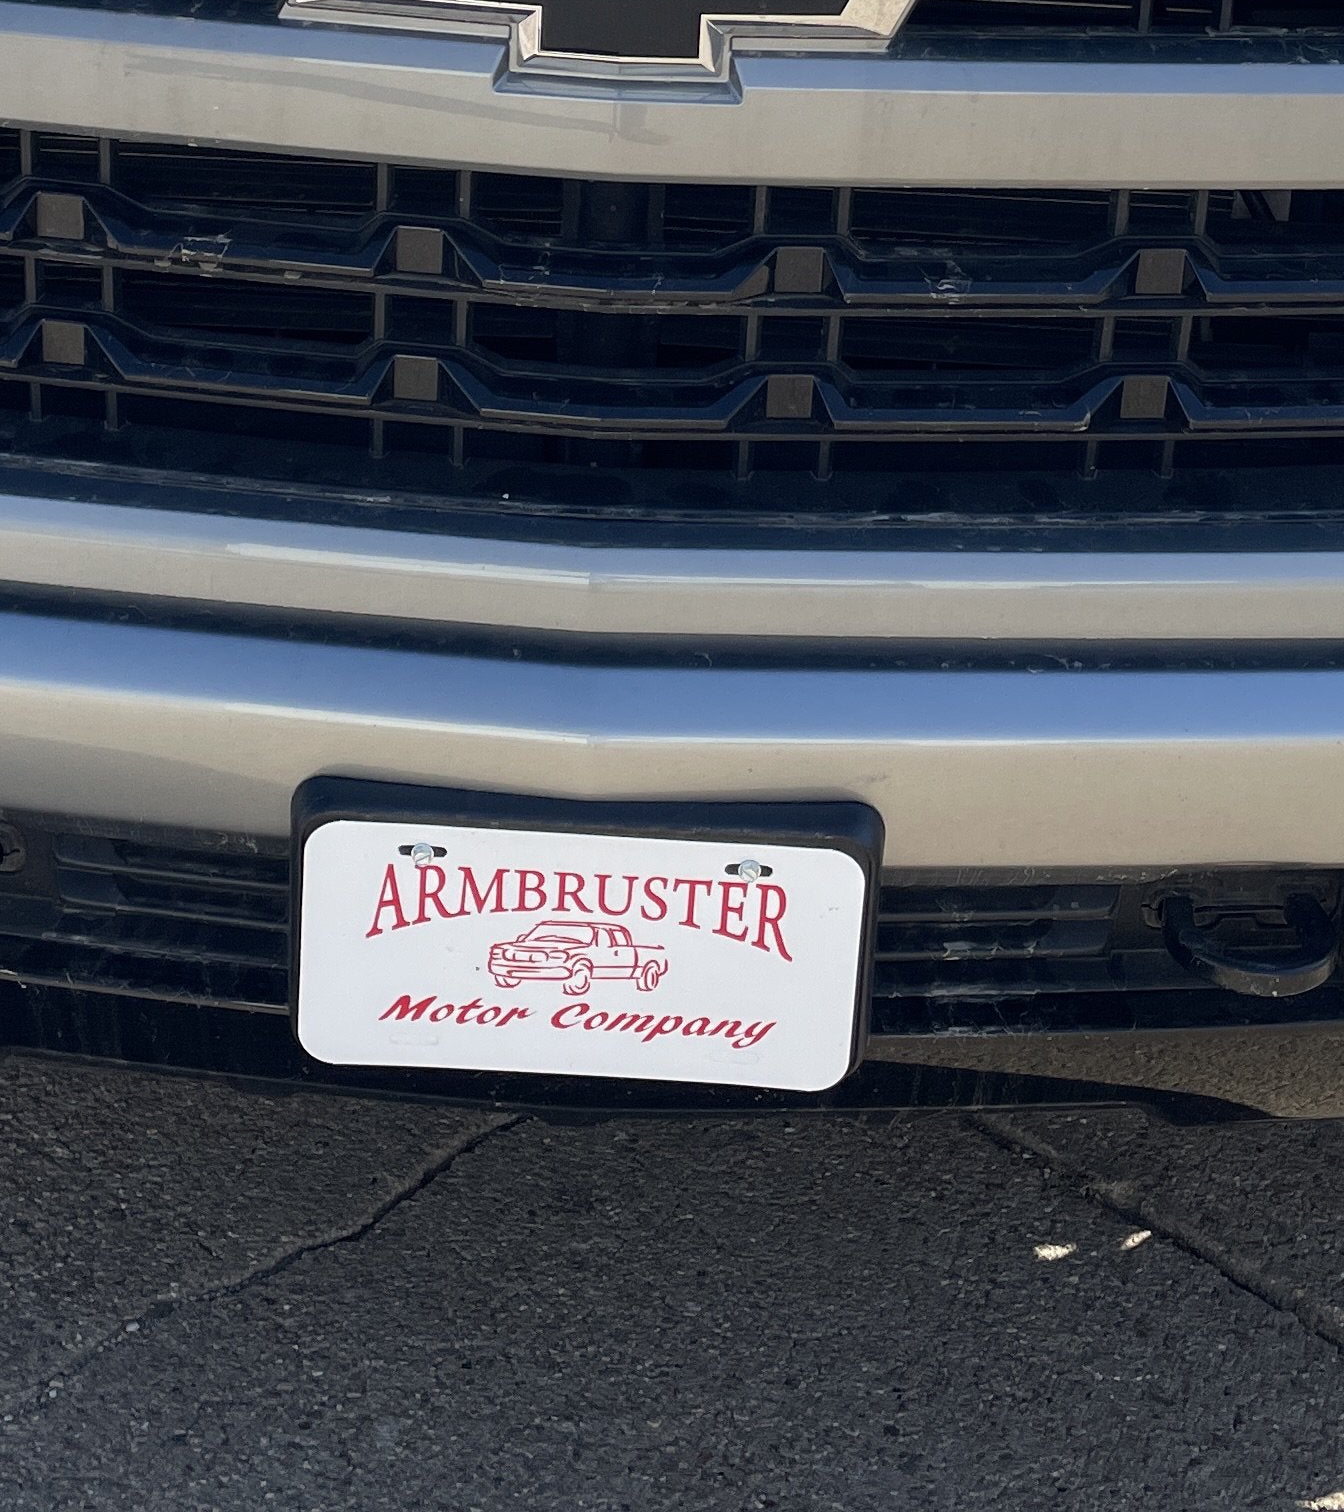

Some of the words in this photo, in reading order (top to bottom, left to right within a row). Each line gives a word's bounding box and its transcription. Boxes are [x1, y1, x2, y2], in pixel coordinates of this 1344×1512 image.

[365, 863, 793, 963] ARMBRUSTER
[378, 994, 537, 1028] Motor
[550, 1002, 777, 1049] Company
